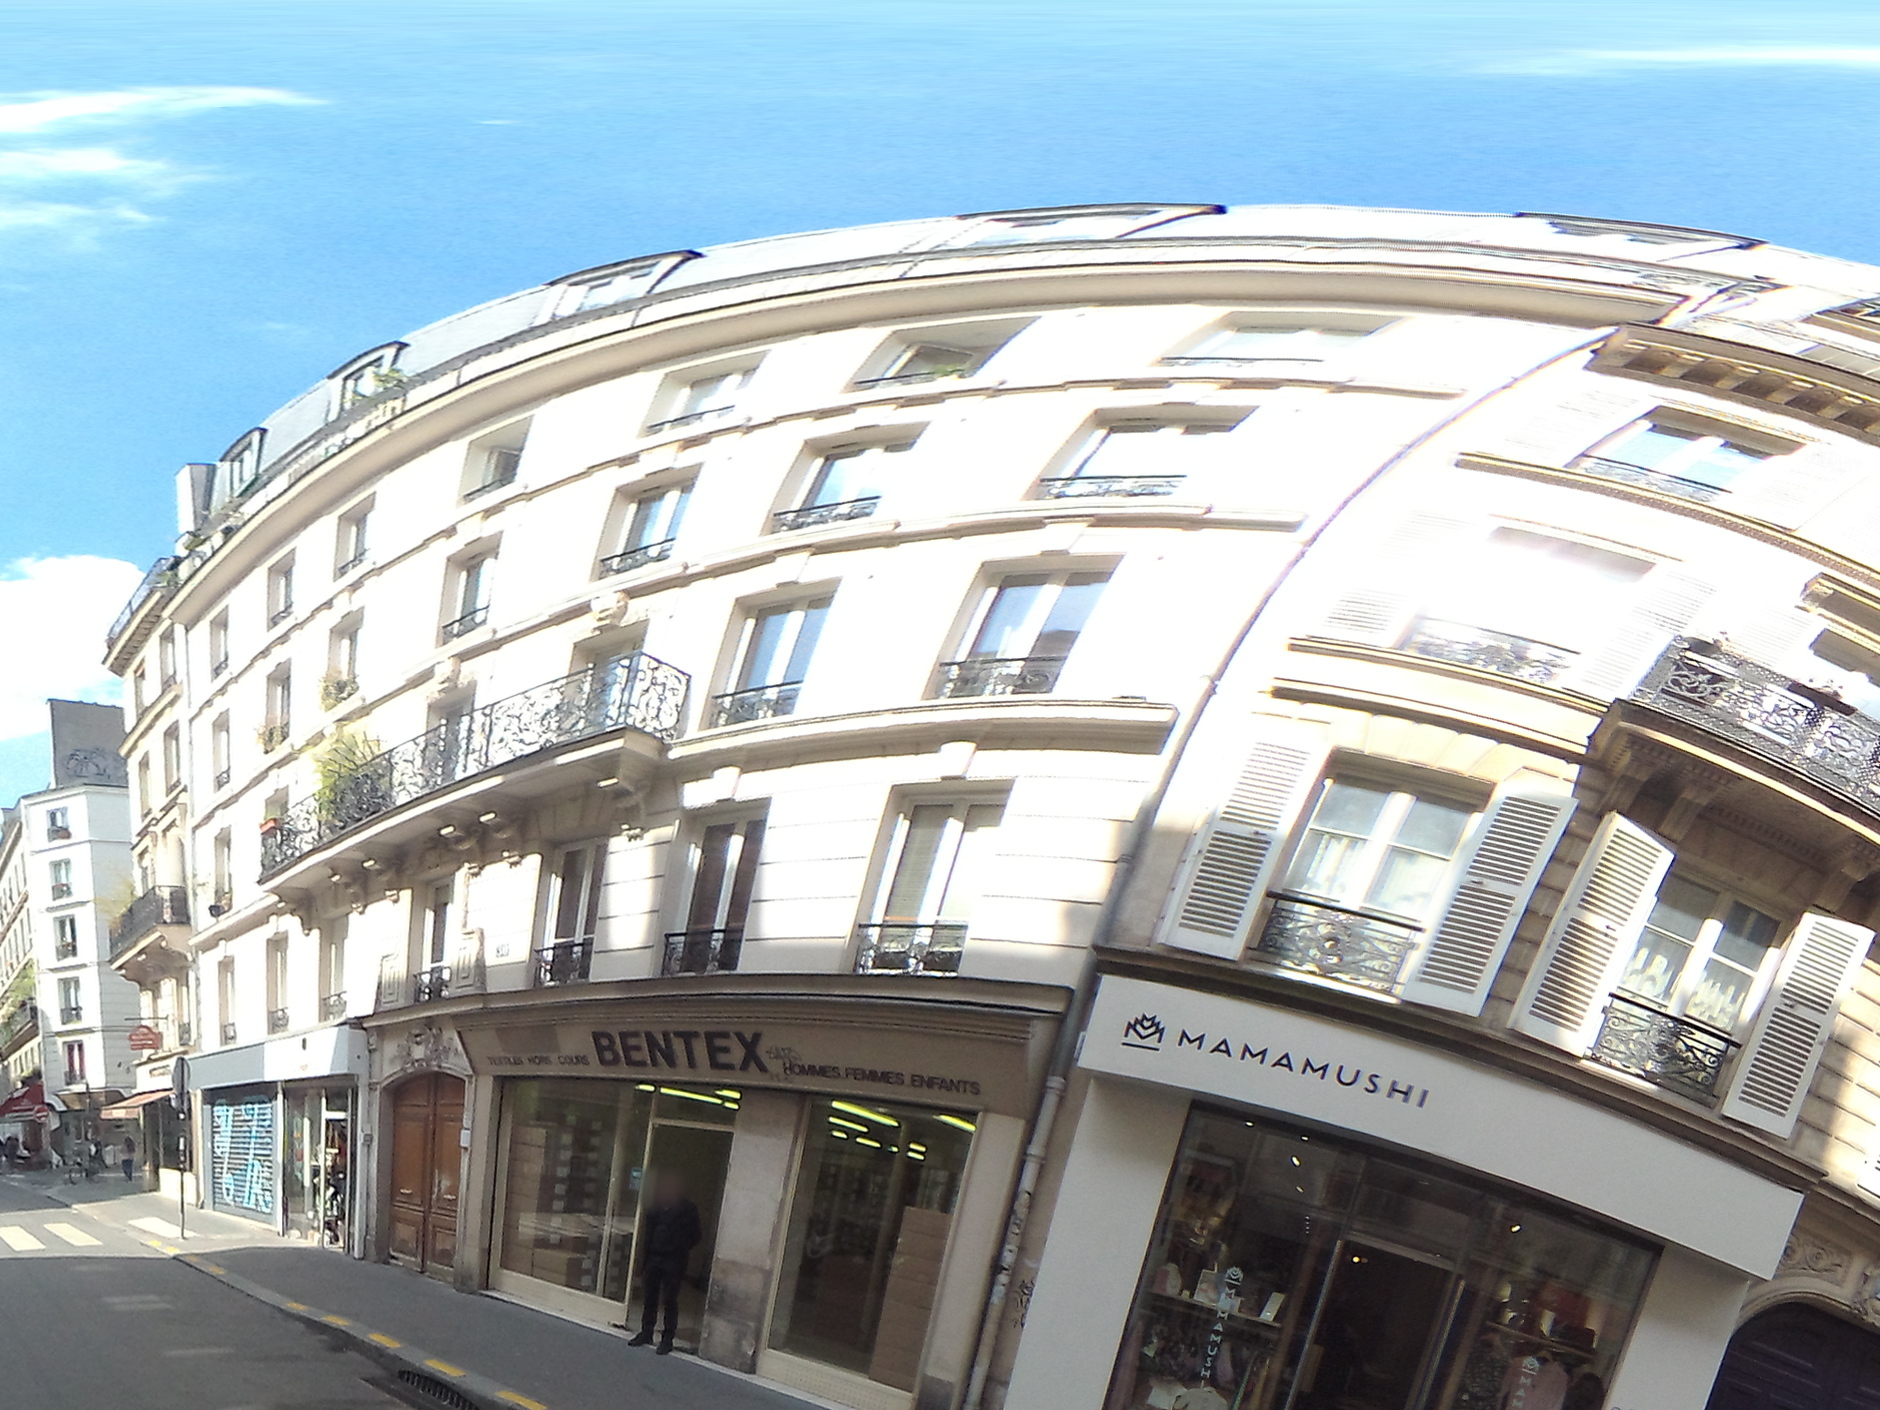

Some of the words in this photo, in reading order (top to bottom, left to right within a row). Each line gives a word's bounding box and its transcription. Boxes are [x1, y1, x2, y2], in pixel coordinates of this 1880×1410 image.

[591, 1029, 769, 1073] BENTEX
[1177, 1028, 1430, 1108] MAMAMUSHI
[845, 1068, 906, 1087] FEMMES
[911, 1075, 982, 1097] ENFANTS
